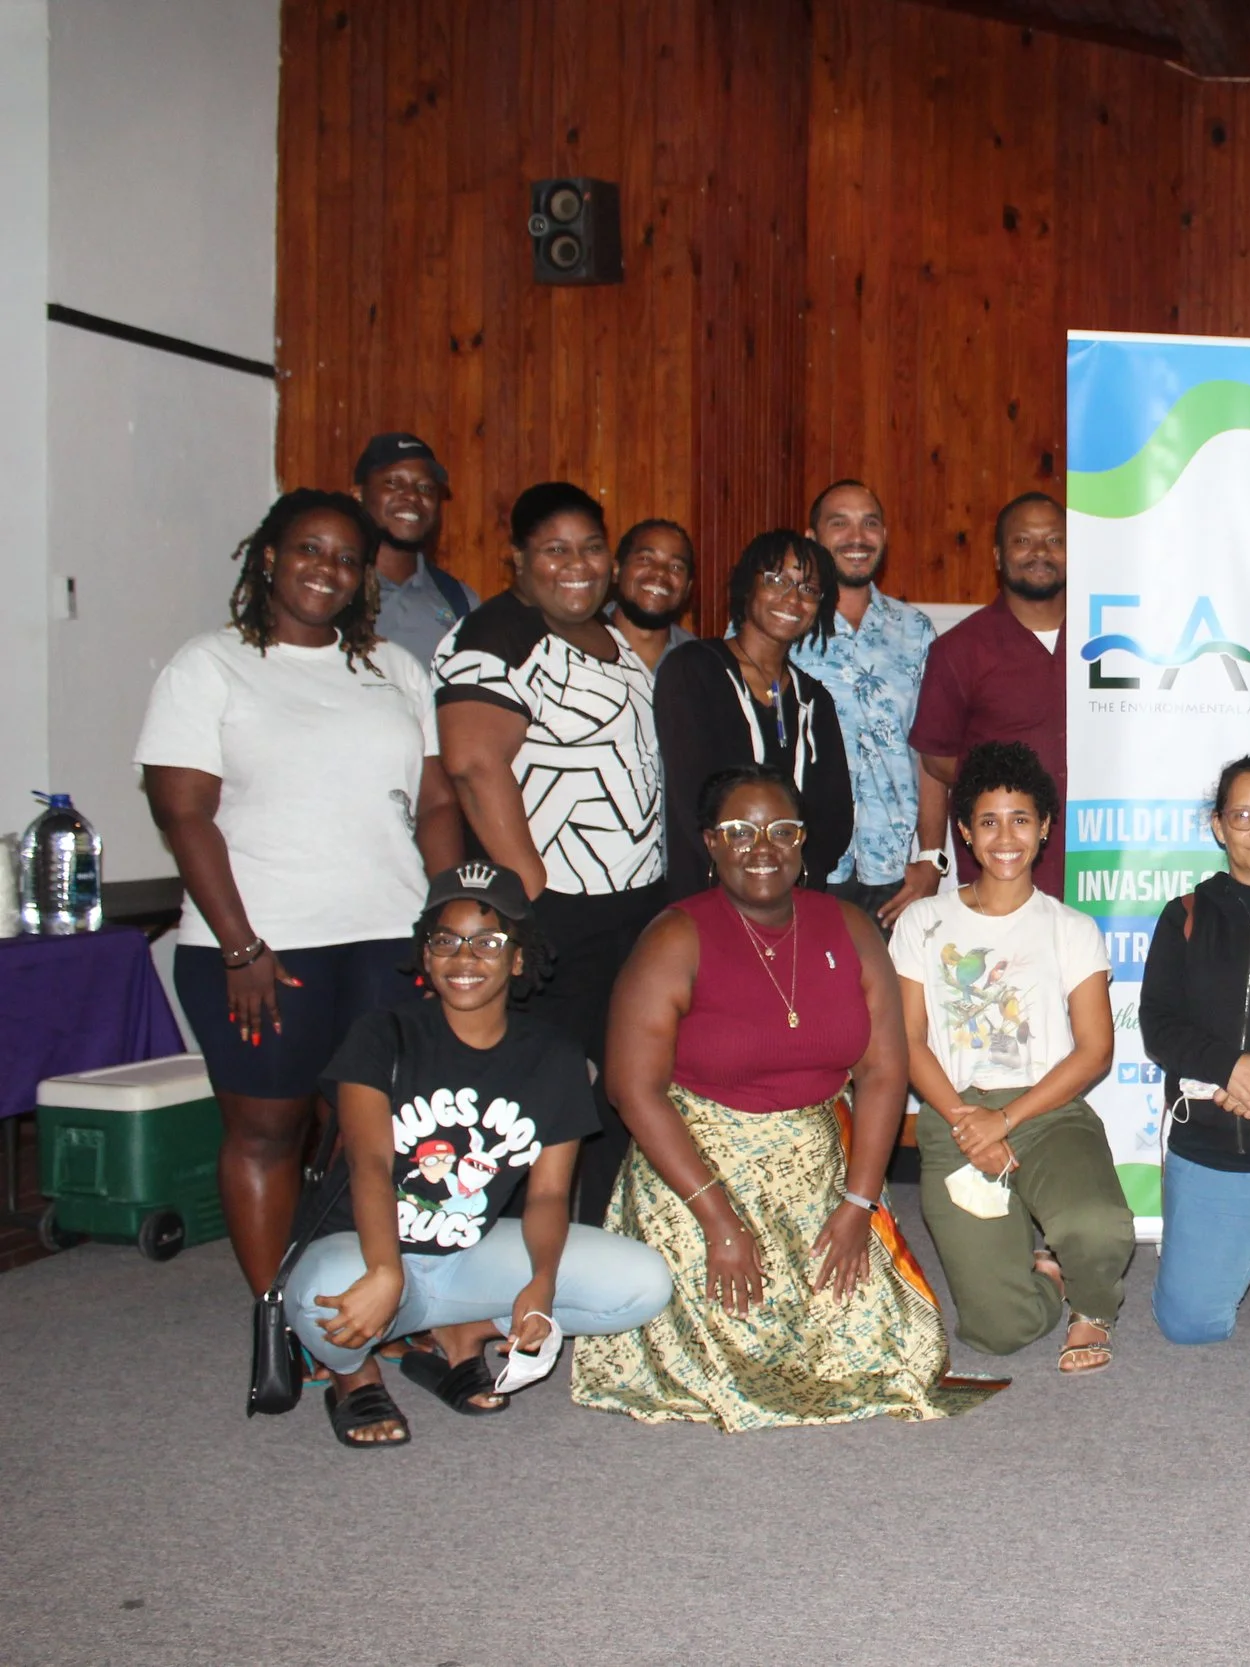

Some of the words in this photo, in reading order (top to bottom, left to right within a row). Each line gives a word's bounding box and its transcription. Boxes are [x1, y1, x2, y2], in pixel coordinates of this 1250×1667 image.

[1077, 870, 1195, 902] INVASIVE
[482, 1097, 542, 1167] NOT
[397, 1200, 487, 1249] RUGS
